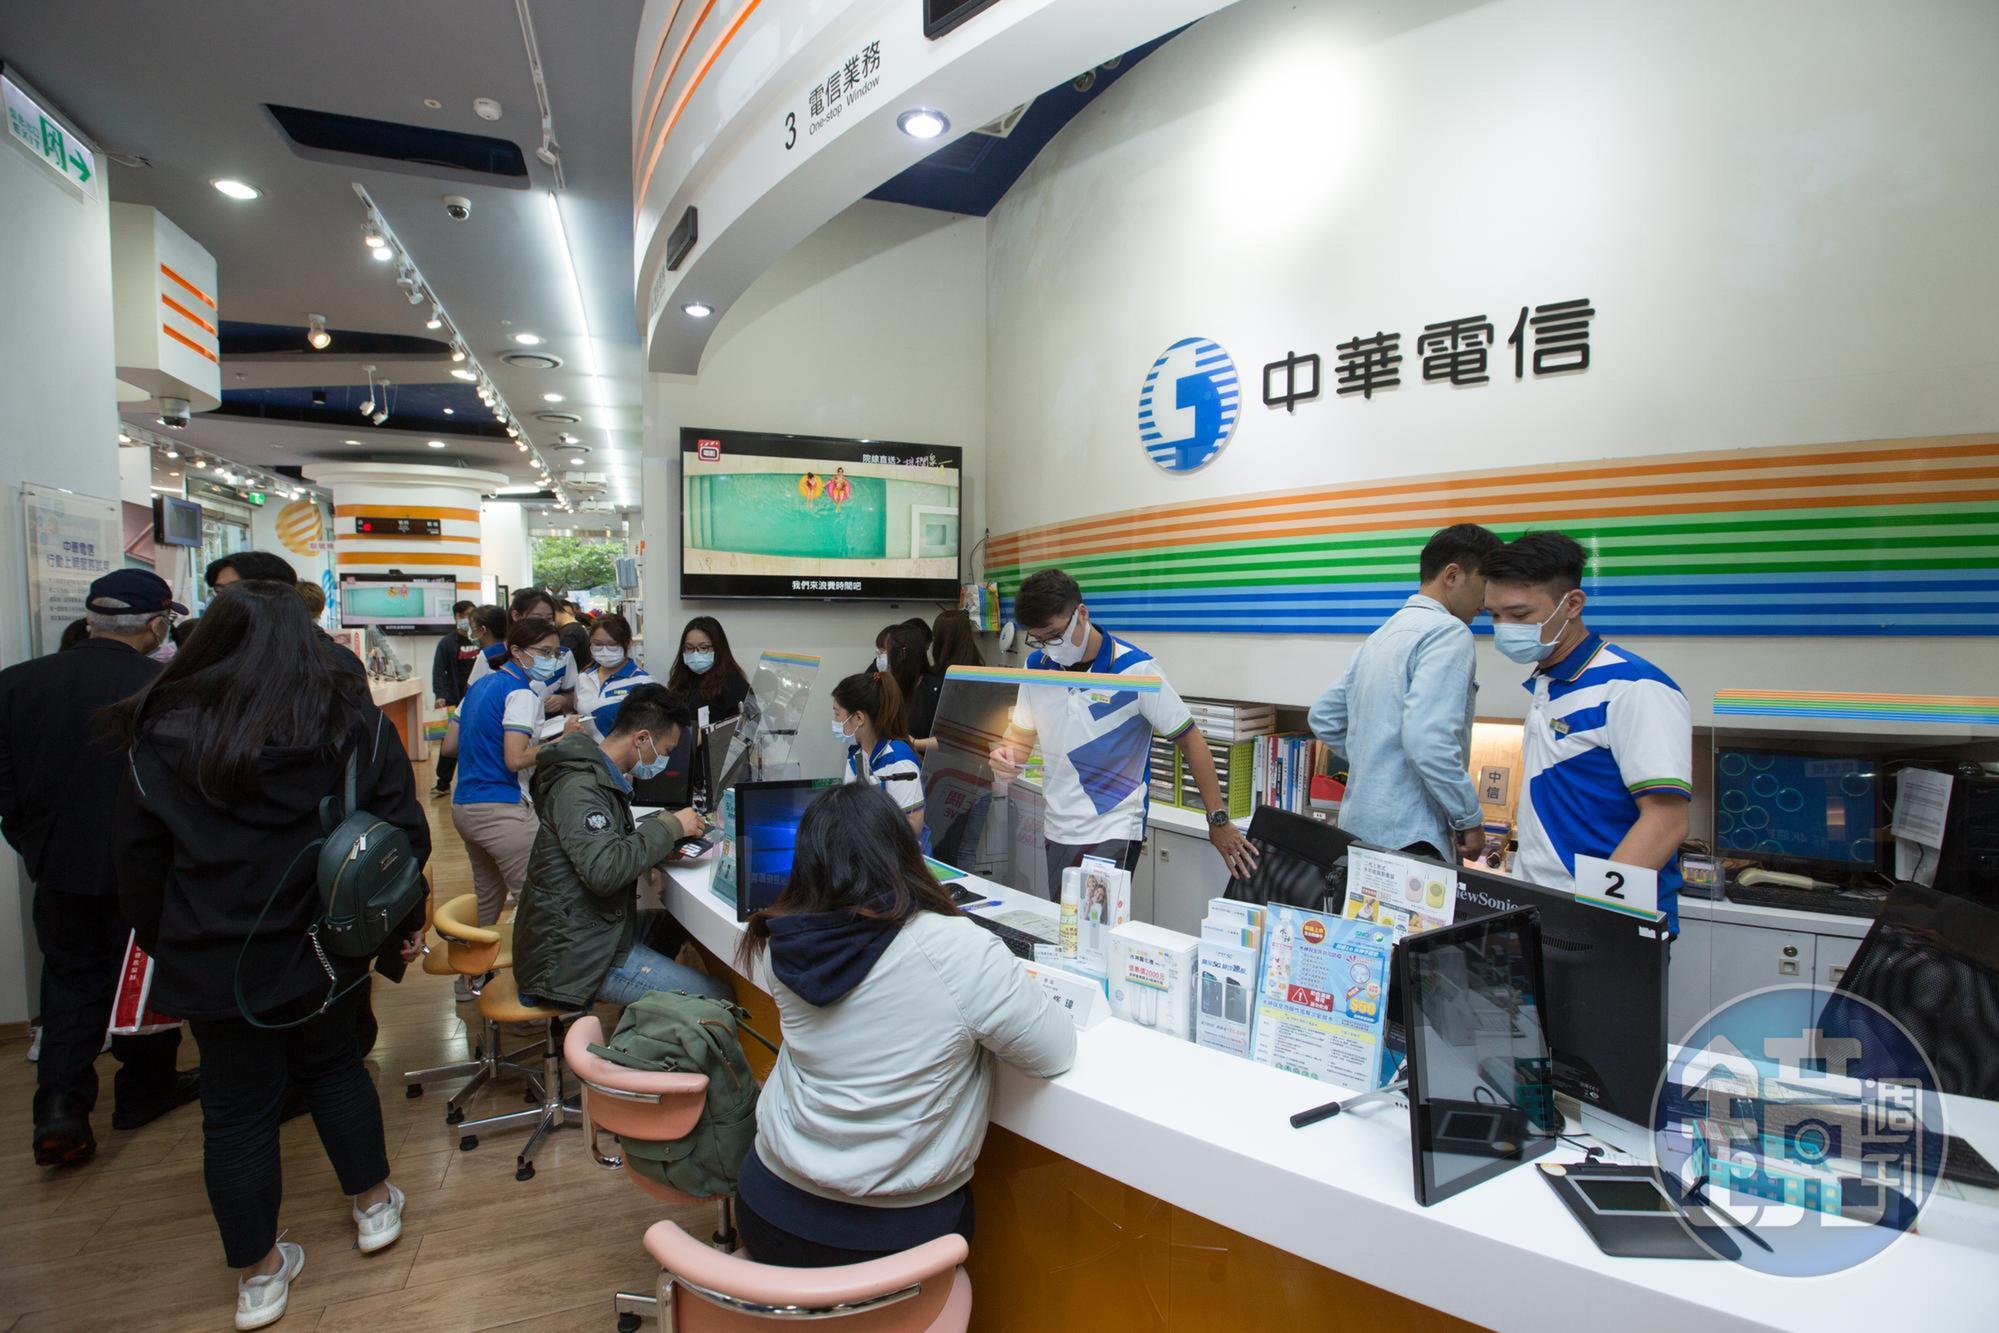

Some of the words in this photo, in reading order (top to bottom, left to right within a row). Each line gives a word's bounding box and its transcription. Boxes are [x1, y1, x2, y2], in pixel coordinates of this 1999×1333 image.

[809, 40, 880, 118] 電信業務
[809, 103, 843, 136] One-stop
[846, 76, 880, 106] Window
[785, 112, 797, 150] 3
[1263, 298, 1596, 412] 中華電信
[792, 580, 862, 592] 我們來浪費時間吧
[1456, 886, 1519, 911] iewSonic
[1605, 871, 1625, 900] 2
